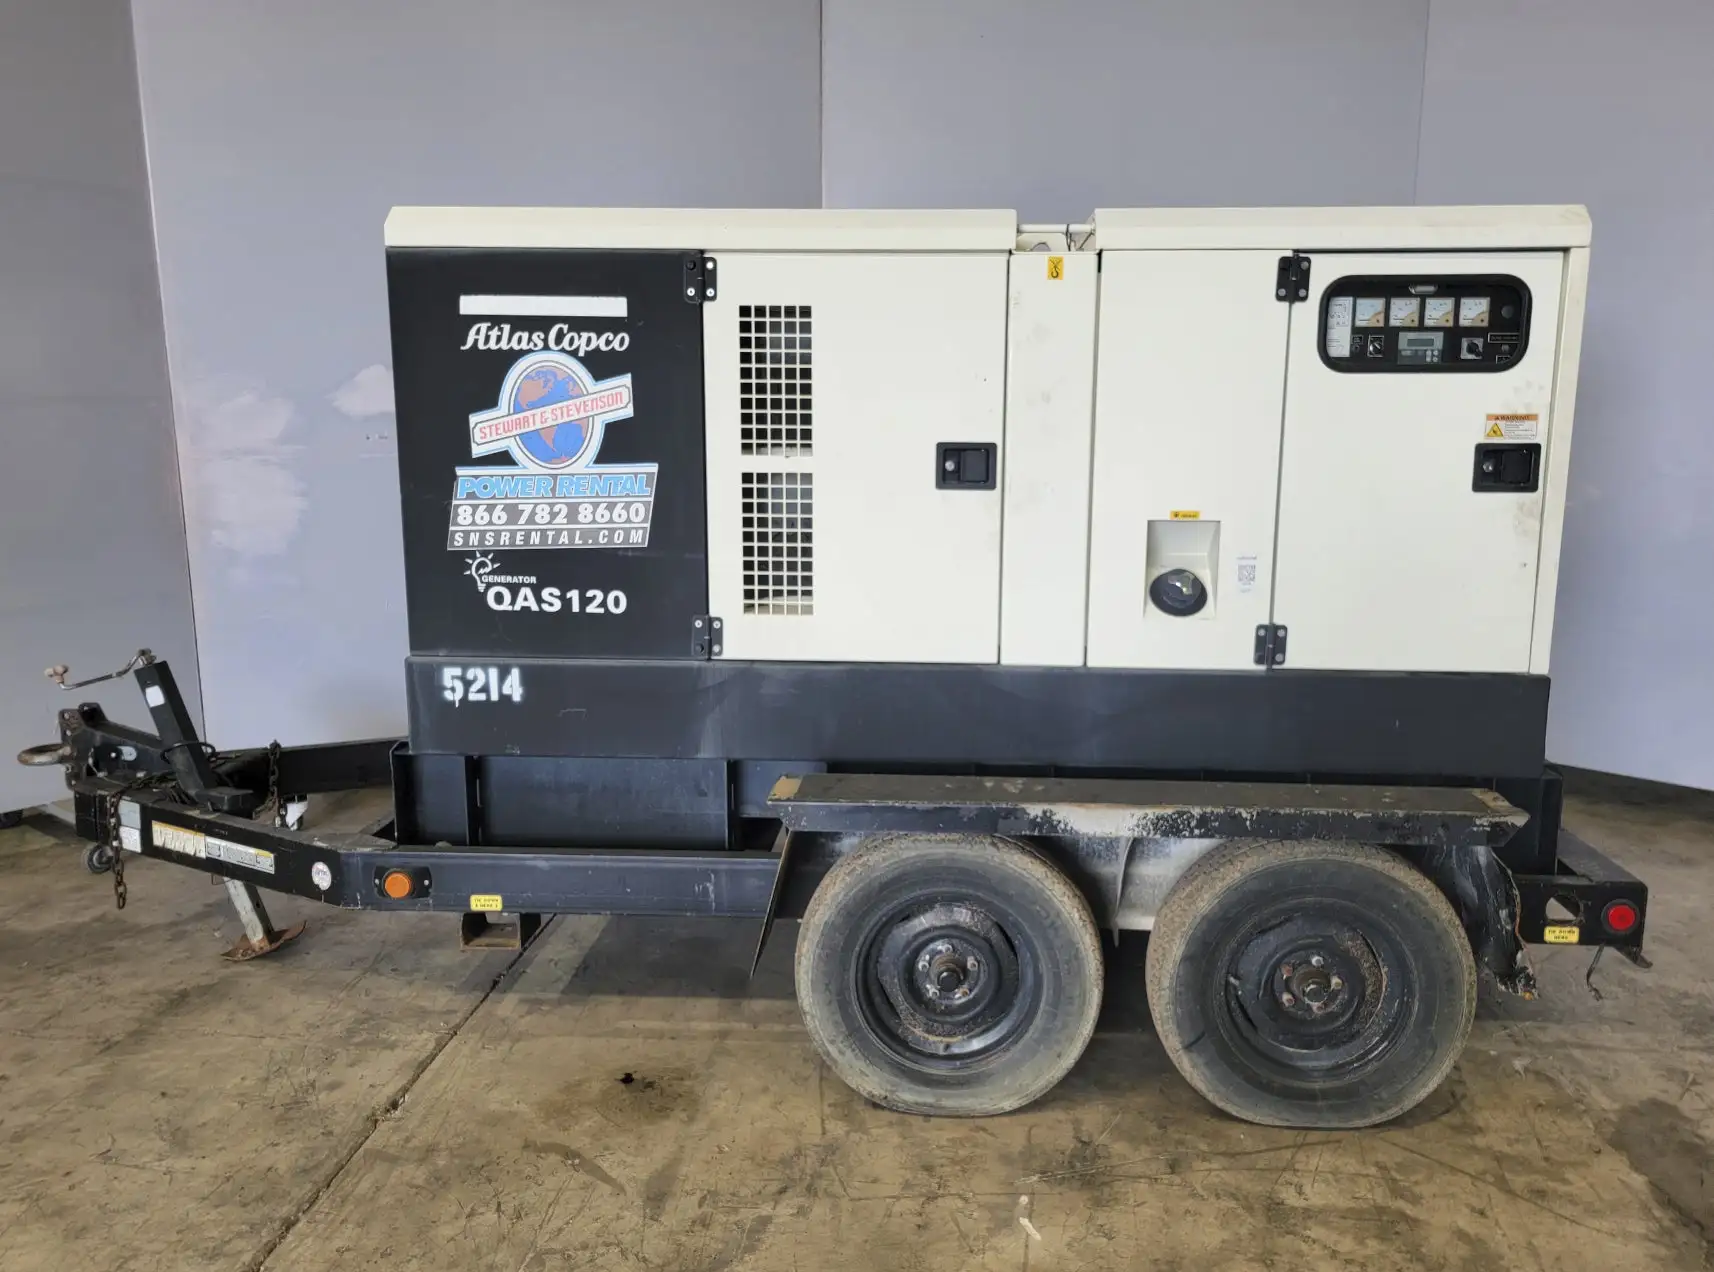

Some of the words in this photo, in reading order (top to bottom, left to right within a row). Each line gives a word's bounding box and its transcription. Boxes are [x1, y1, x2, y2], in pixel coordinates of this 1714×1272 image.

[460, 322, 545, 351] Atlas
[548, 323, 630, 357] Copco
[478, 414, 537, 440] STEWART
[540, 411, 550, 425] &
[551, 391, 624, 422] STEVENSON
[456, 475, 554, 499] POWER
[556, 474, 651, 497] RENTAL
[457, 504, 508, 526] 866
[517, 503, 569, 525] 782
[577, 502, 646, 524] 8660
[453, 529, 644, 547] SNSRENTAL.COM
[481, 575, 537, 584] GENERATOR
[486, 586, 627, 614] QAS120
[443, 667, 523, 704] 5214
